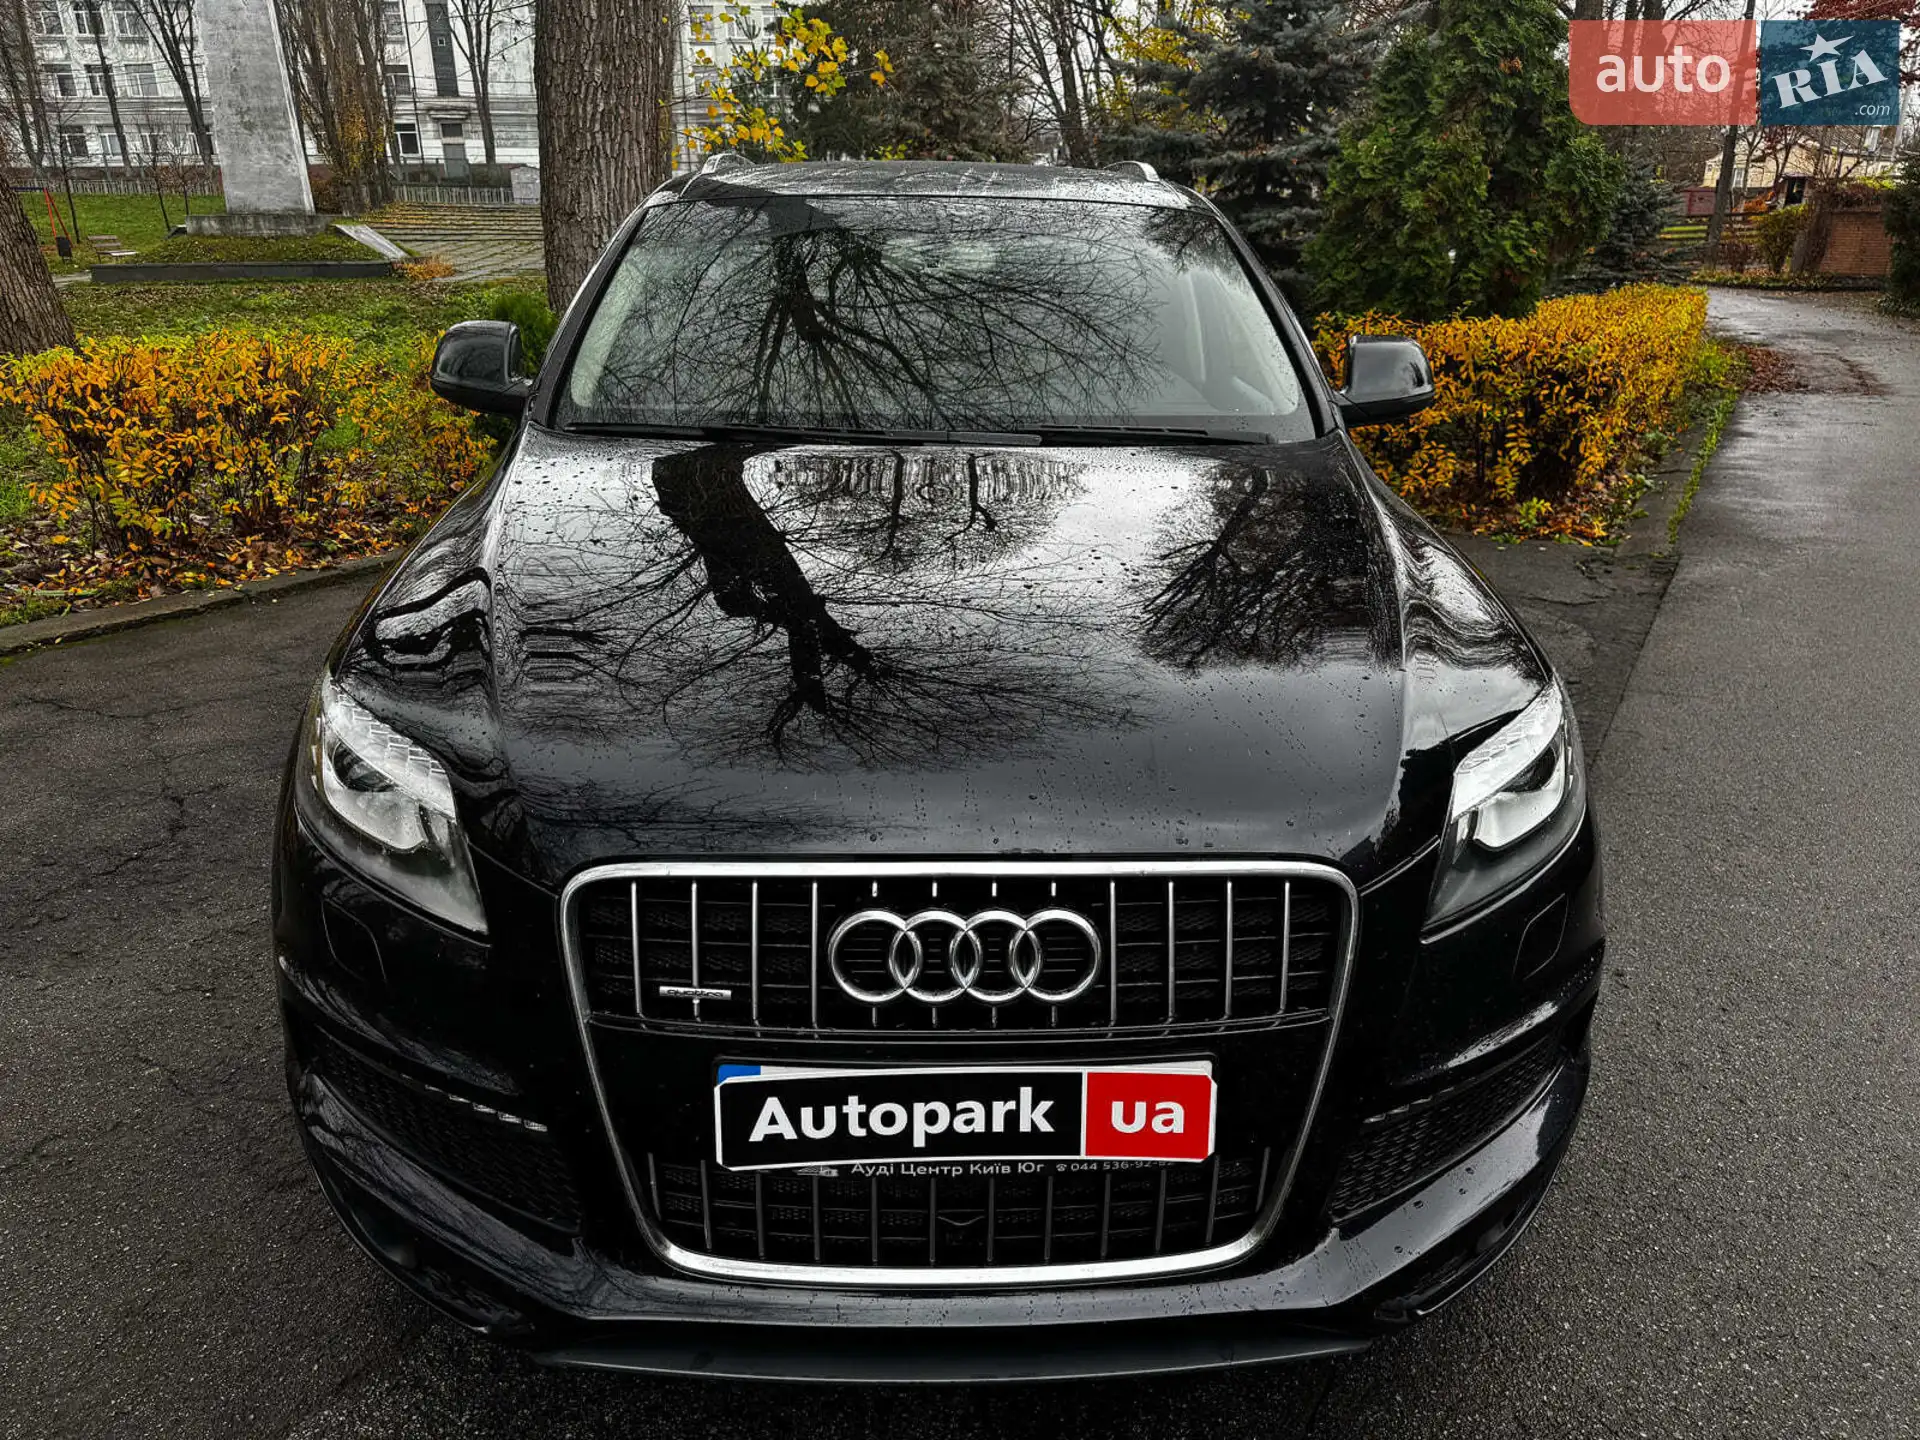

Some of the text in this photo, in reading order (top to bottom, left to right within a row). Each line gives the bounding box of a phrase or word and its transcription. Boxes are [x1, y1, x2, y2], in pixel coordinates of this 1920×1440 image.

[748, 1086, 1185, 1148] Autopark ua
[851, 1163, 894, 1178] Ауді
[901, 1163, 963, 1178] Центр
[970, 1161, 1012, 1175] Київ
[1018, 1161, 1045, 1173] Юг
[1070, 1162, 1099, 1172] 044
